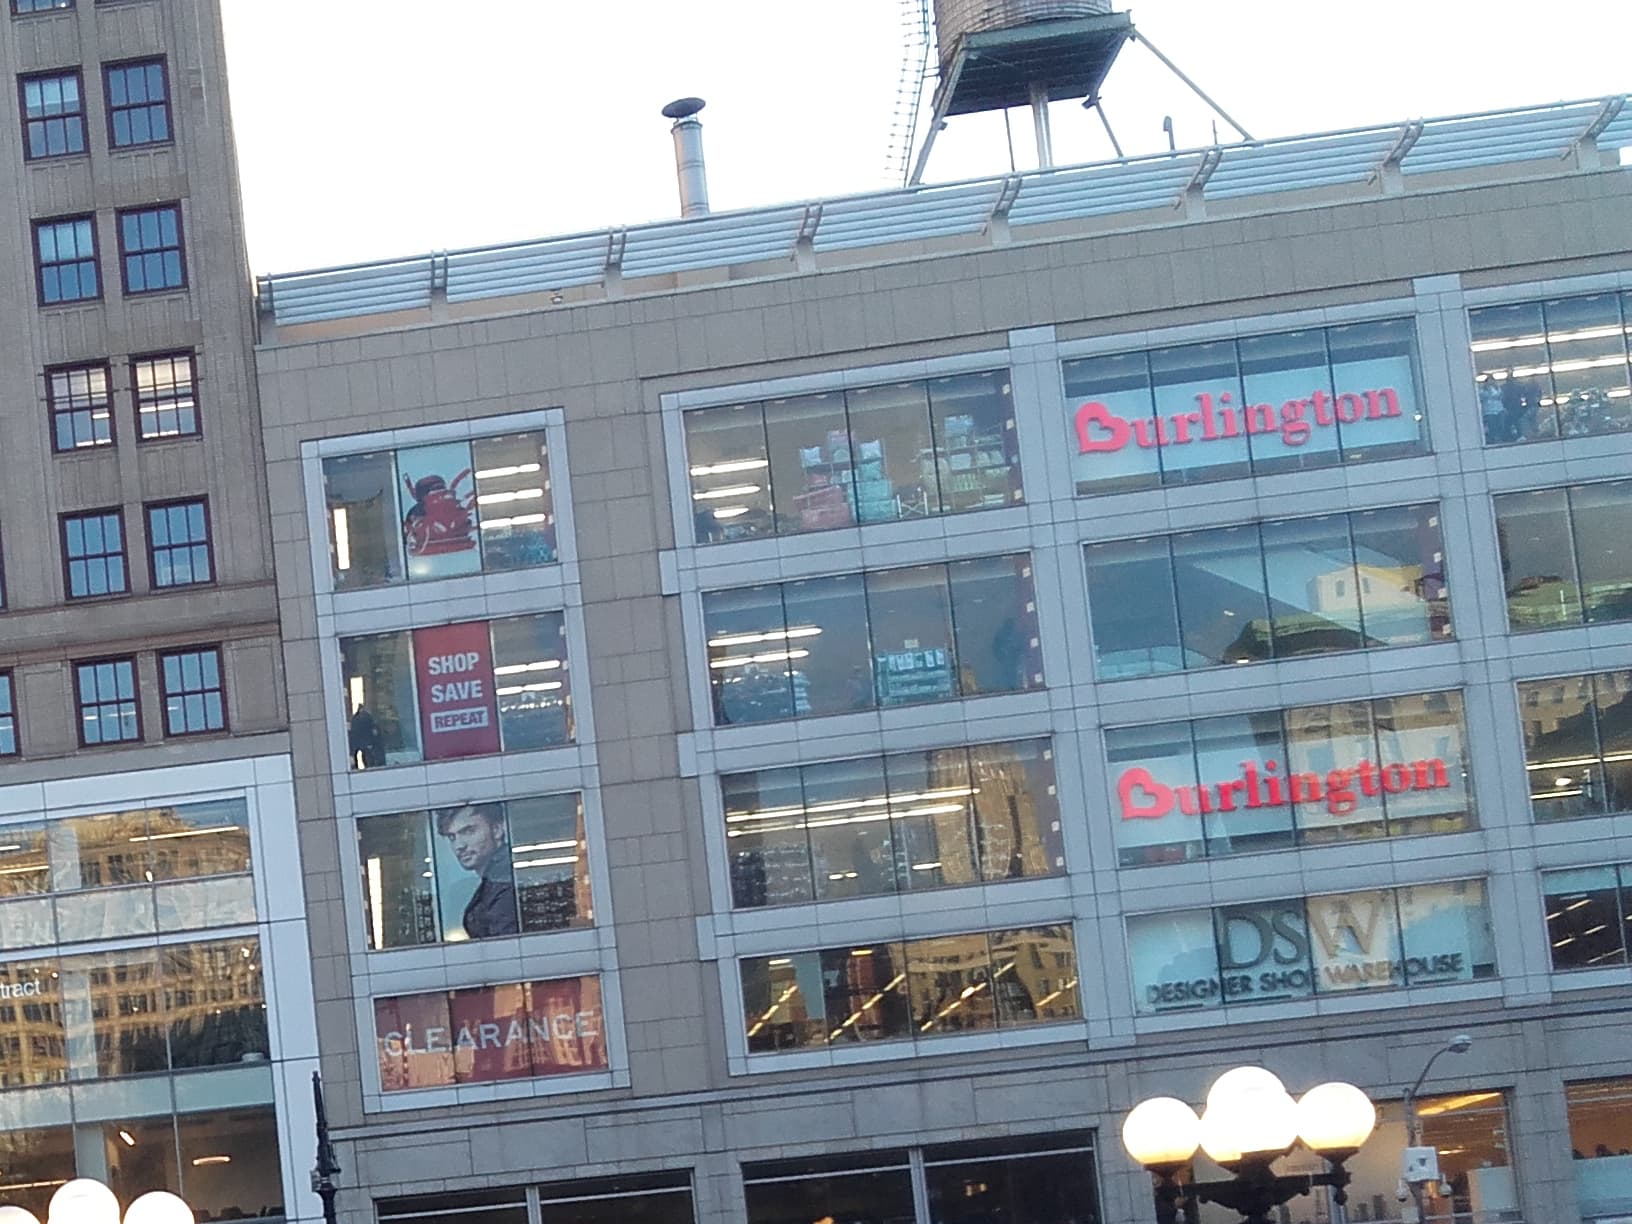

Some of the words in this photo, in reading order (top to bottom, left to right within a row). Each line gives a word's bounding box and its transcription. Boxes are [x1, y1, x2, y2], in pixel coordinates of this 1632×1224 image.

[1074, 388, 1402, 455] Burlington
[428, 651, 480, 675] SHOP
[431, 679, 484, 703] SAVE
[434, 710, 484, 729] REPEAT
[1117, 756, 1450, 821] Burlington
[1219, 903, 1380, 970] DSW
[1145, 973, 1254, 1005] DESIGNER
[1323, 952, 1465, 985] WAREHOUSE
[384, 1009, 600, 1057] CLEARANCE
